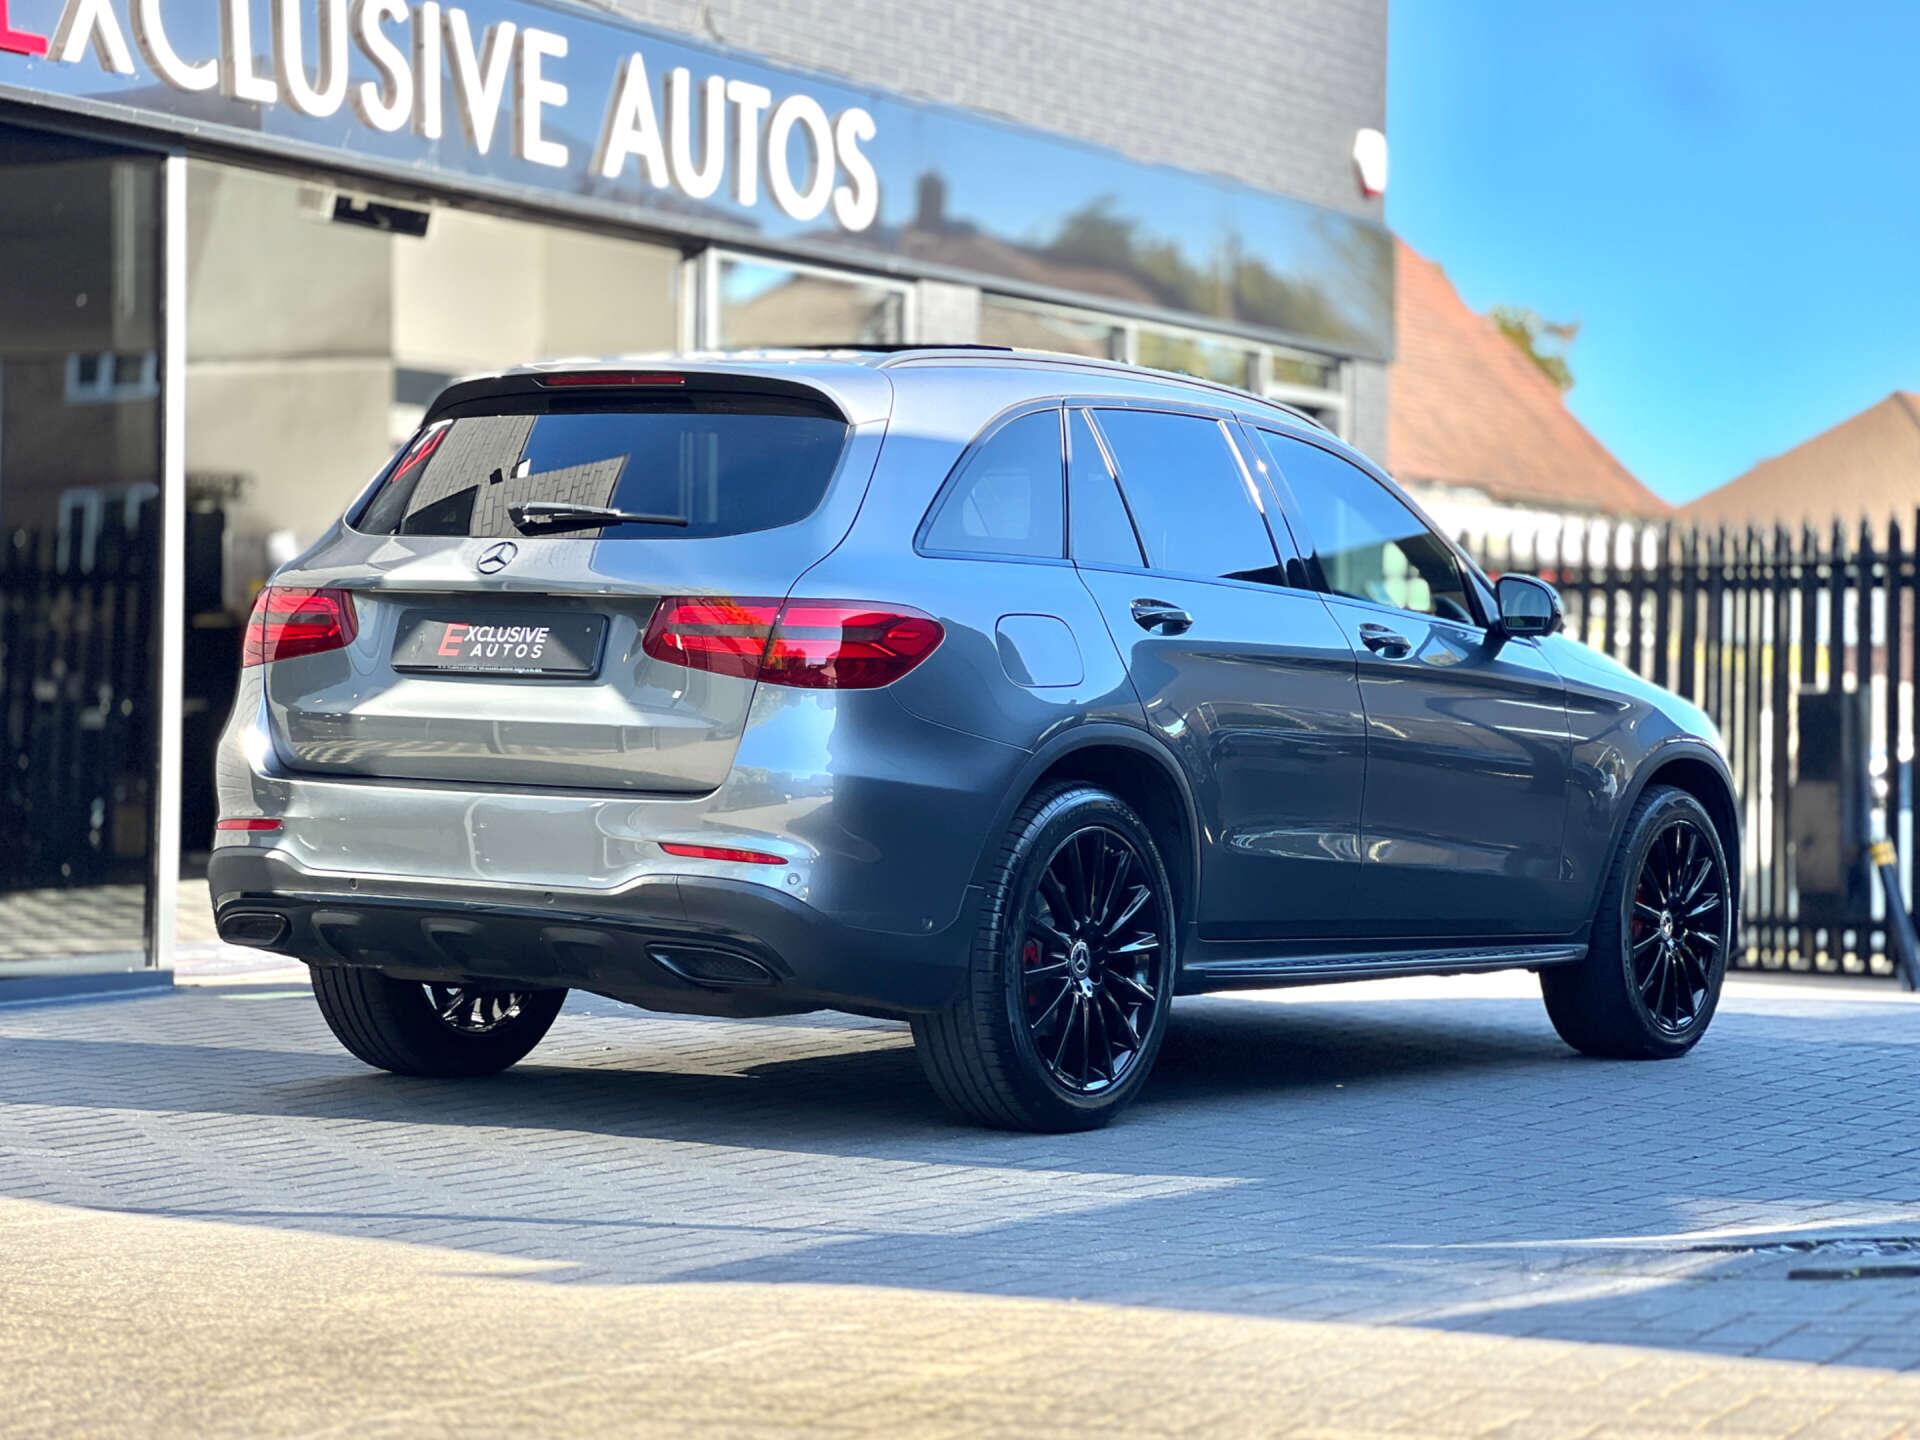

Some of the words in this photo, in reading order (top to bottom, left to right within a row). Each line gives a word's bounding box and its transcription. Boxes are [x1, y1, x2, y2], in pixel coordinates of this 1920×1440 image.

[0, 0, 569, 167] CLUSIVE
[602, 52, 879, 232] AUTOS
[438, 622, 550, 656] EXCLUSIVE
[470, 643, 544, 659] AUTOS
